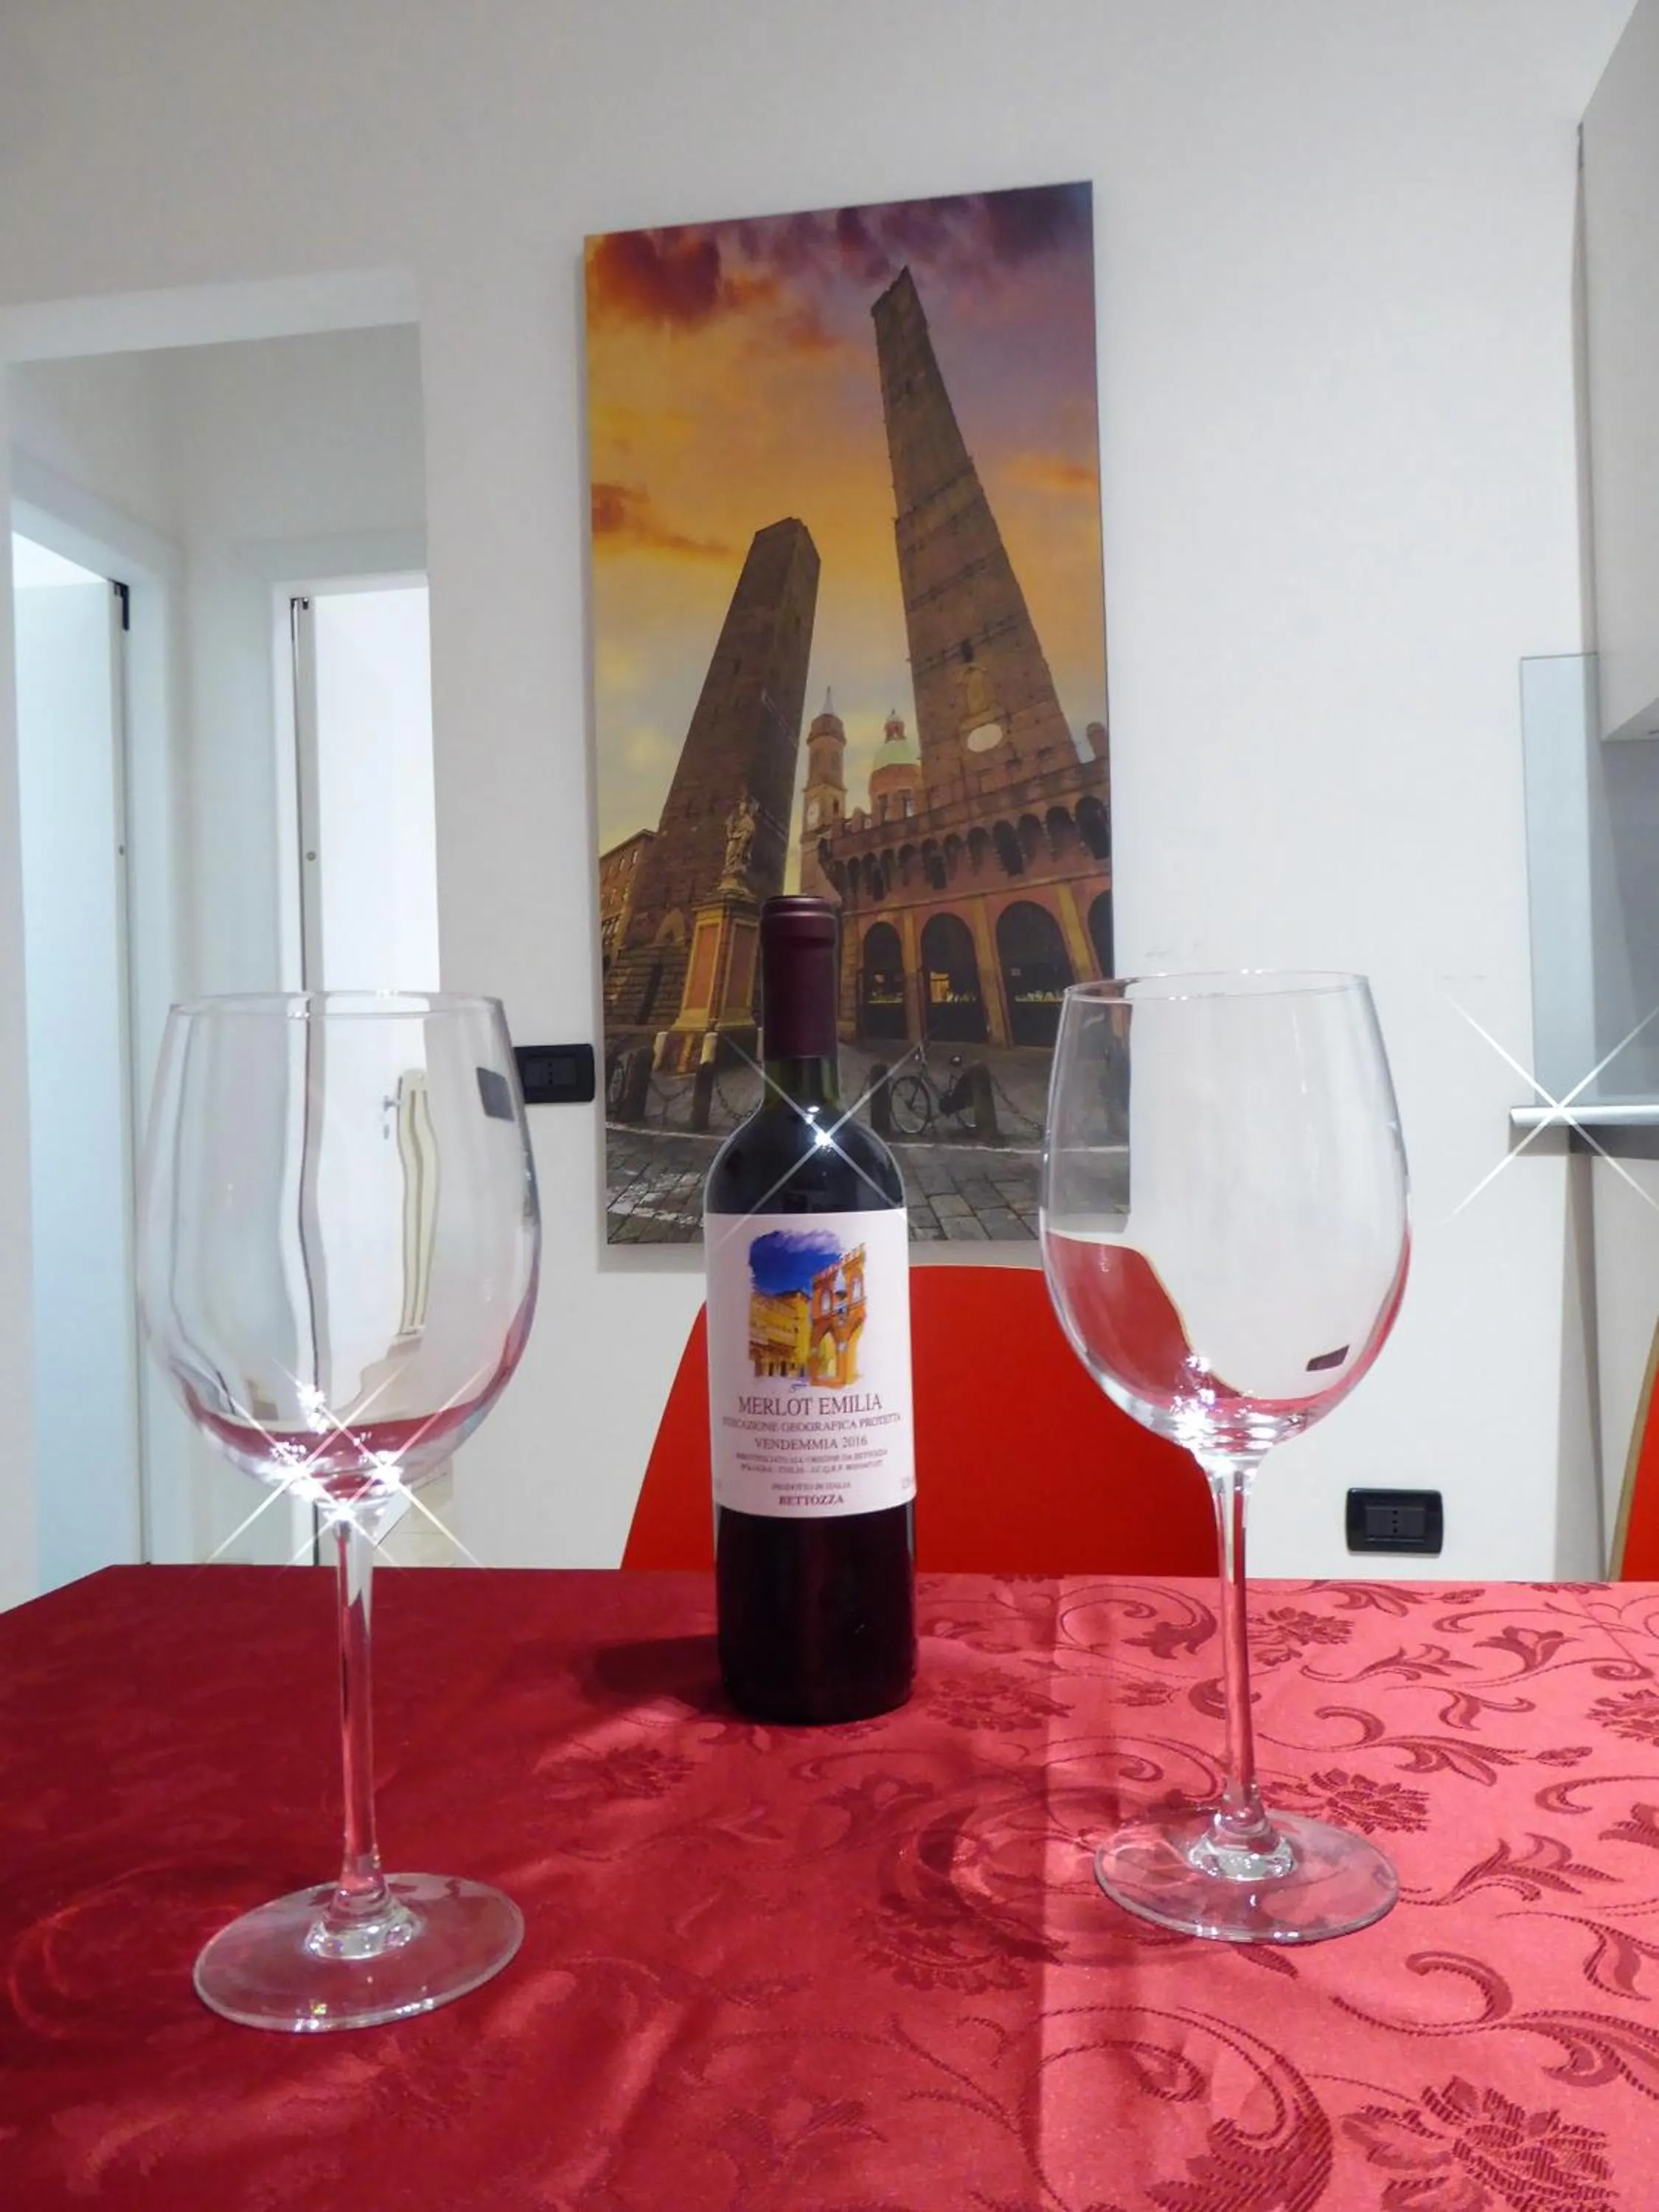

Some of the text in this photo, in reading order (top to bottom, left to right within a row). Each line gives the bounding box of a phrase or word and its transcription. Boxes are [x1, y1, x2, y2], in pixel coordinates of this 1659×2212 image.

[738, 1393, 882, 1415] MERLOT EMILIA
[782, 1419, 857, 1432] GEOGRAFICA
[754, 1436, 868, 1450] VENDEMMIA 2016
